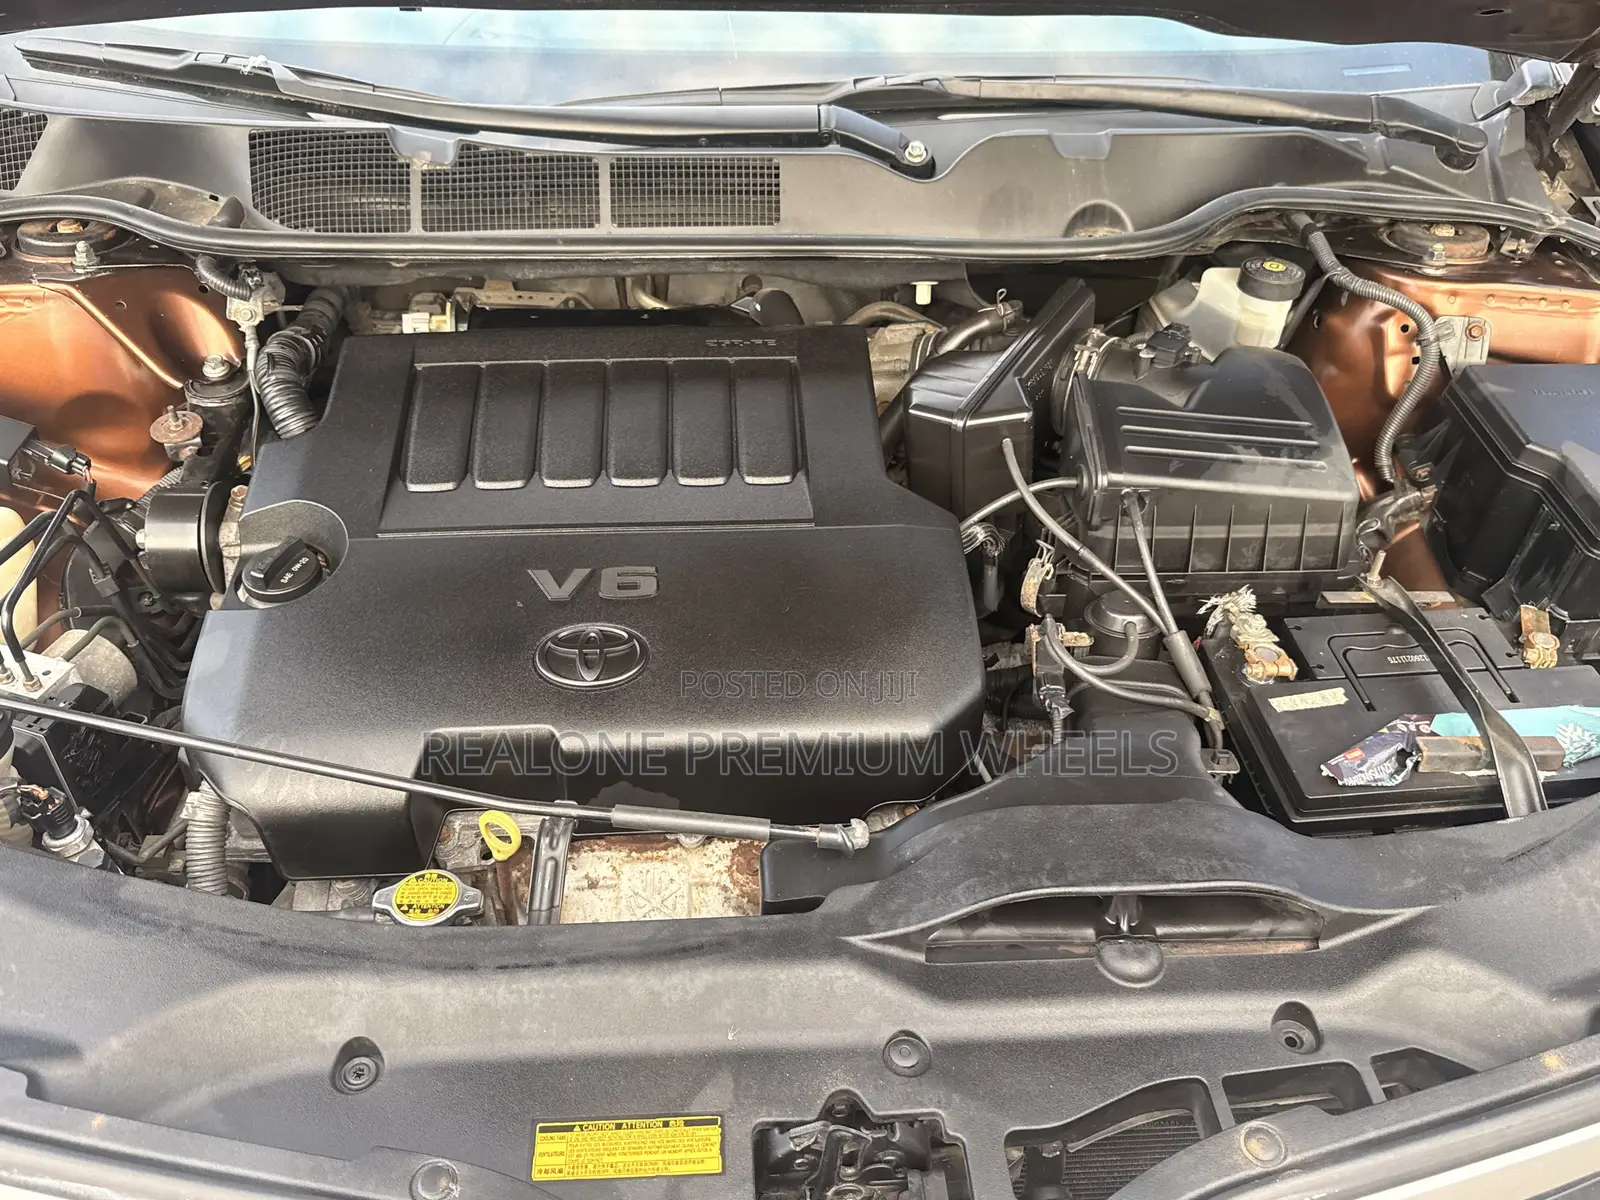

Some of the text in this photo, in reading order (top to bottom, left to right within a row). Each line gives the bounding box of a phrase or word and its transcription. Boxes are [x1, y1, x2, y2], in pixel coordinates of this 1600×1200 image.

[280, 572, 294, 584] SAE
[527, 566, 658, 601] V6
[582, 1120, 663, 1131] CAUTION ATTENTION
